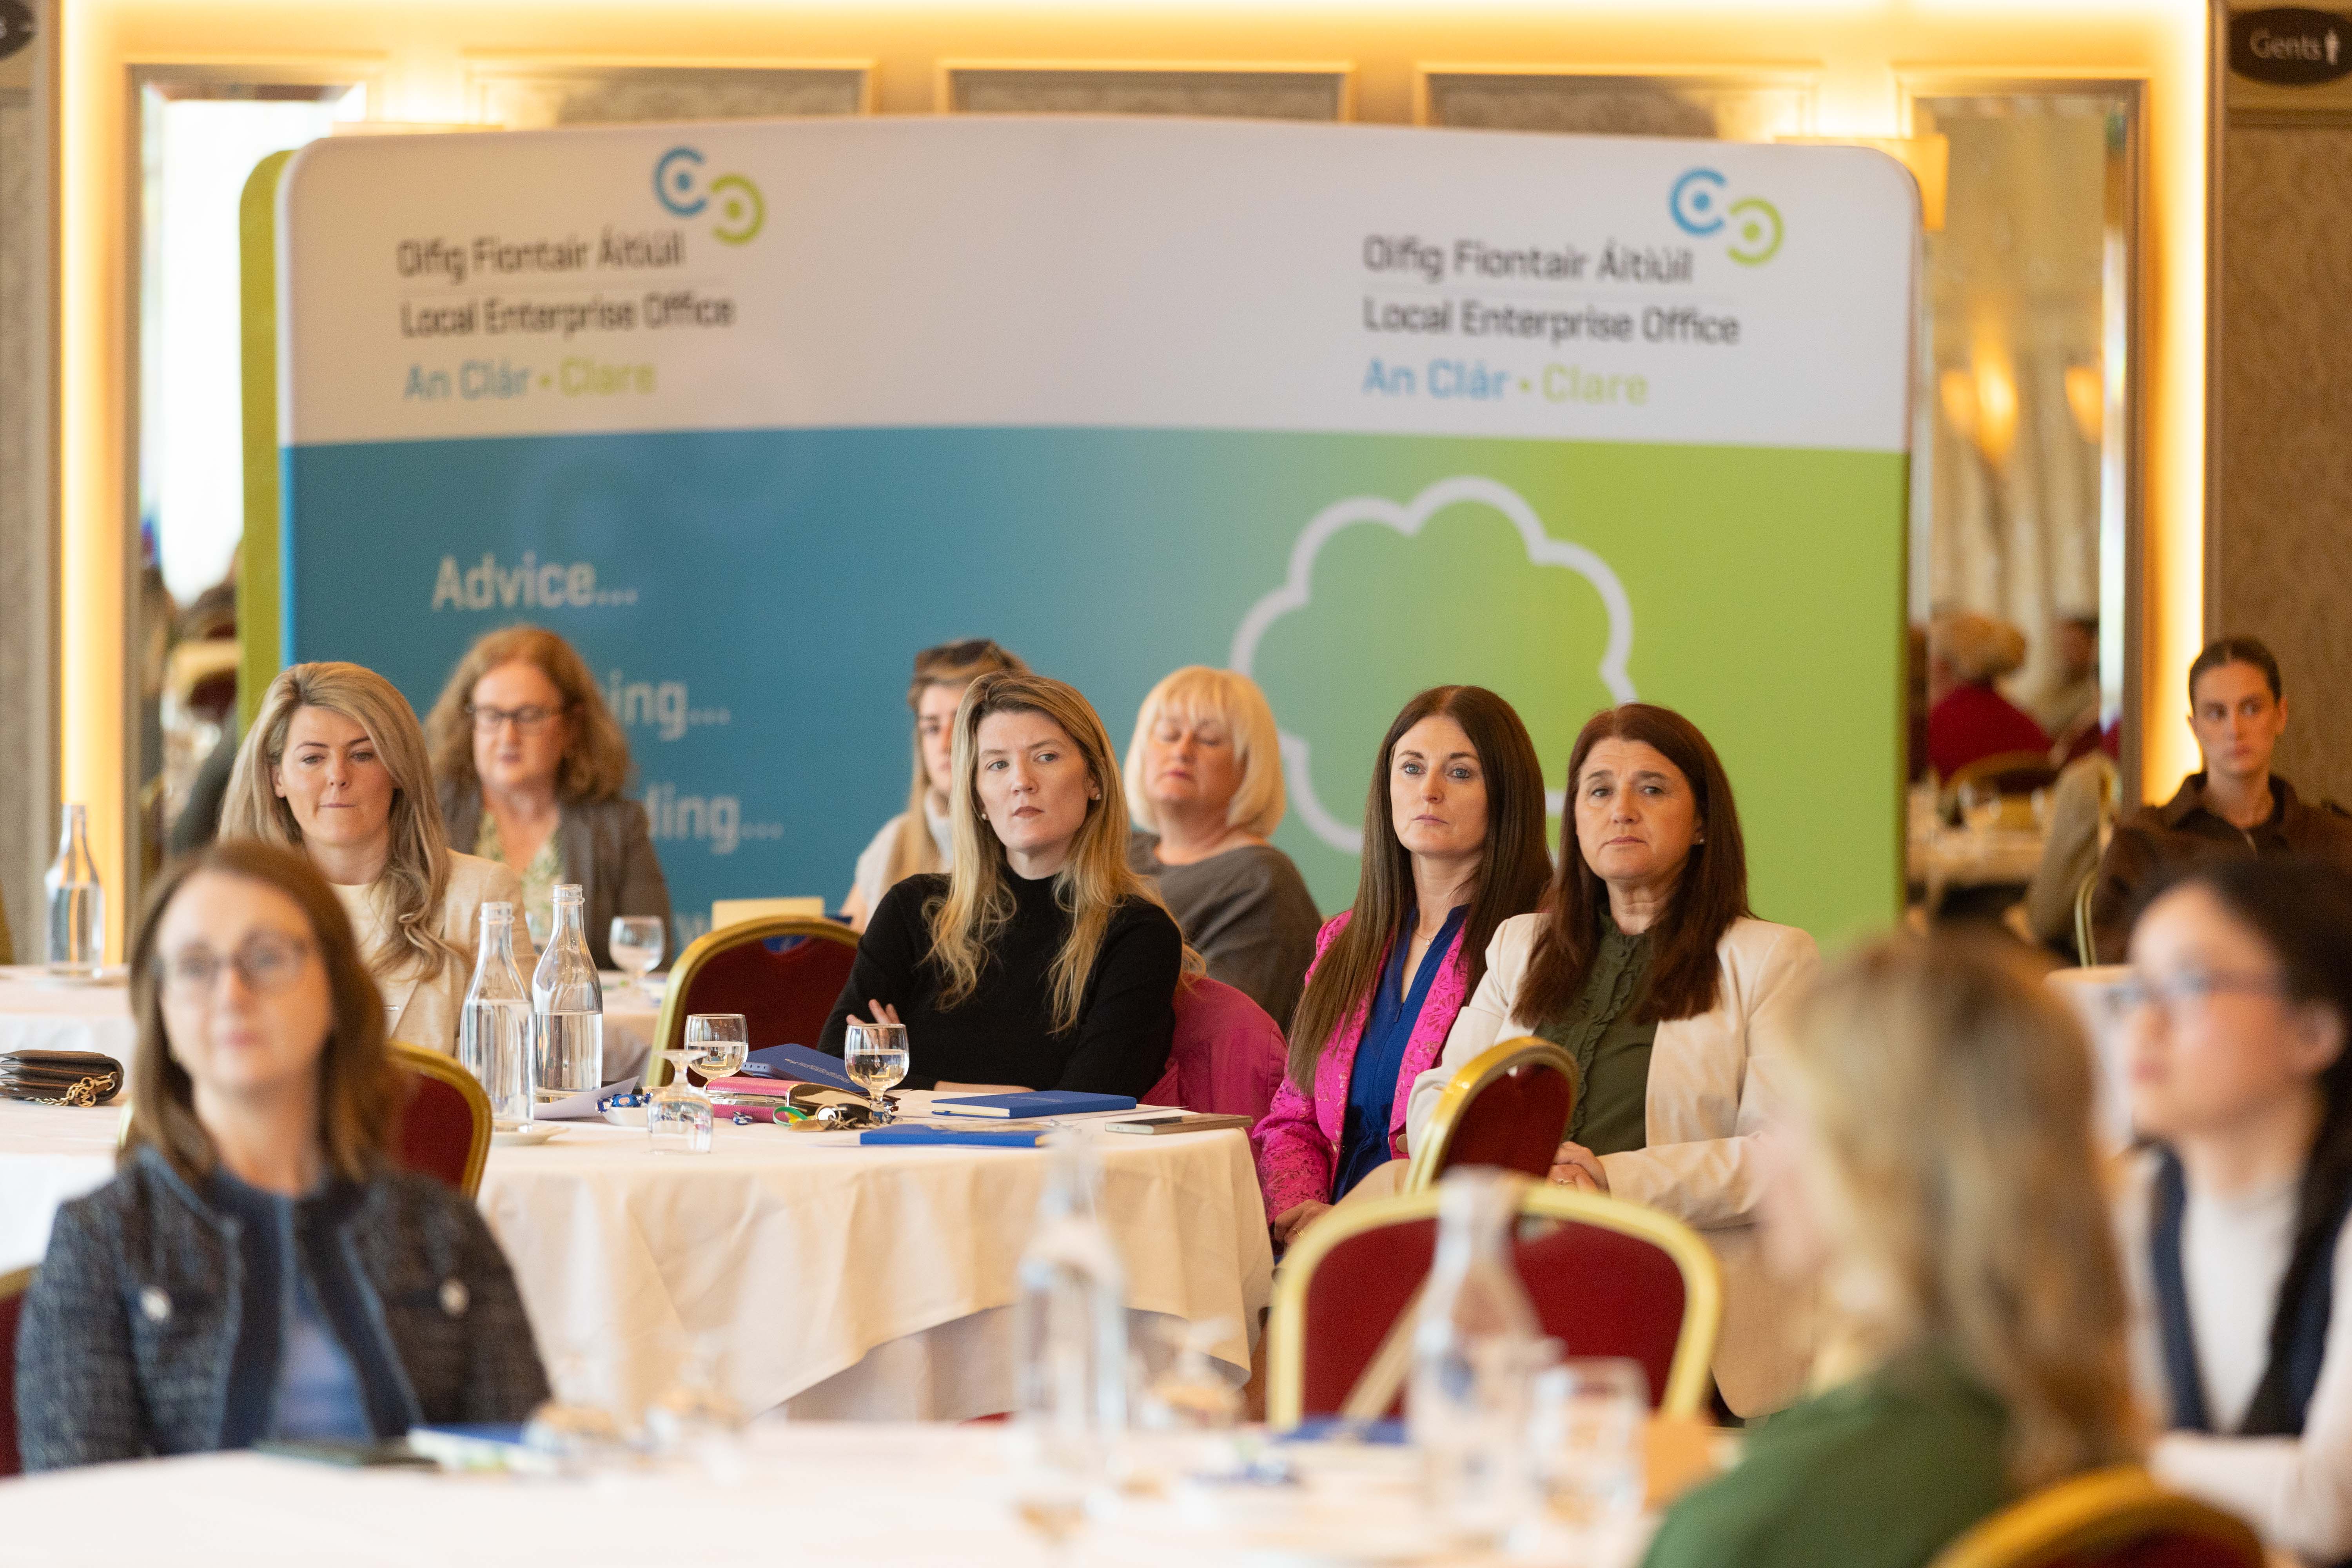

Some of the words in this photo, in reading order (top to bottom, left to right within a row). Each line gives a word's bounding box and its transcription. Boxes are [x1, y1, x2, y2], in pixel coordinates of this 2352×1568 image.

[2249, 29, 2322, 60] Gents
[472, 236, 590, 273] Fiontair
[1454, 239, 1588, 280] Fiontair
[401, 303, 477, 338] Local
[484, 298, 638, 339] Enterprise
[643, 290, 735, 329] Office
[1363, 298, 1452, 334] Local
[1461, 299, 1634, 347] Enterprise
[1642, 306, 1740, 345] Office
[404, 364, 451, 400] An
[459, 359, 531, 401] Clár
[559, 356, 656, 397] Clare
[1362, 358, 1416, 395] An
[1427, 358, 1510, 401] Clár
[1541, 362, 1649, 406] Clare
